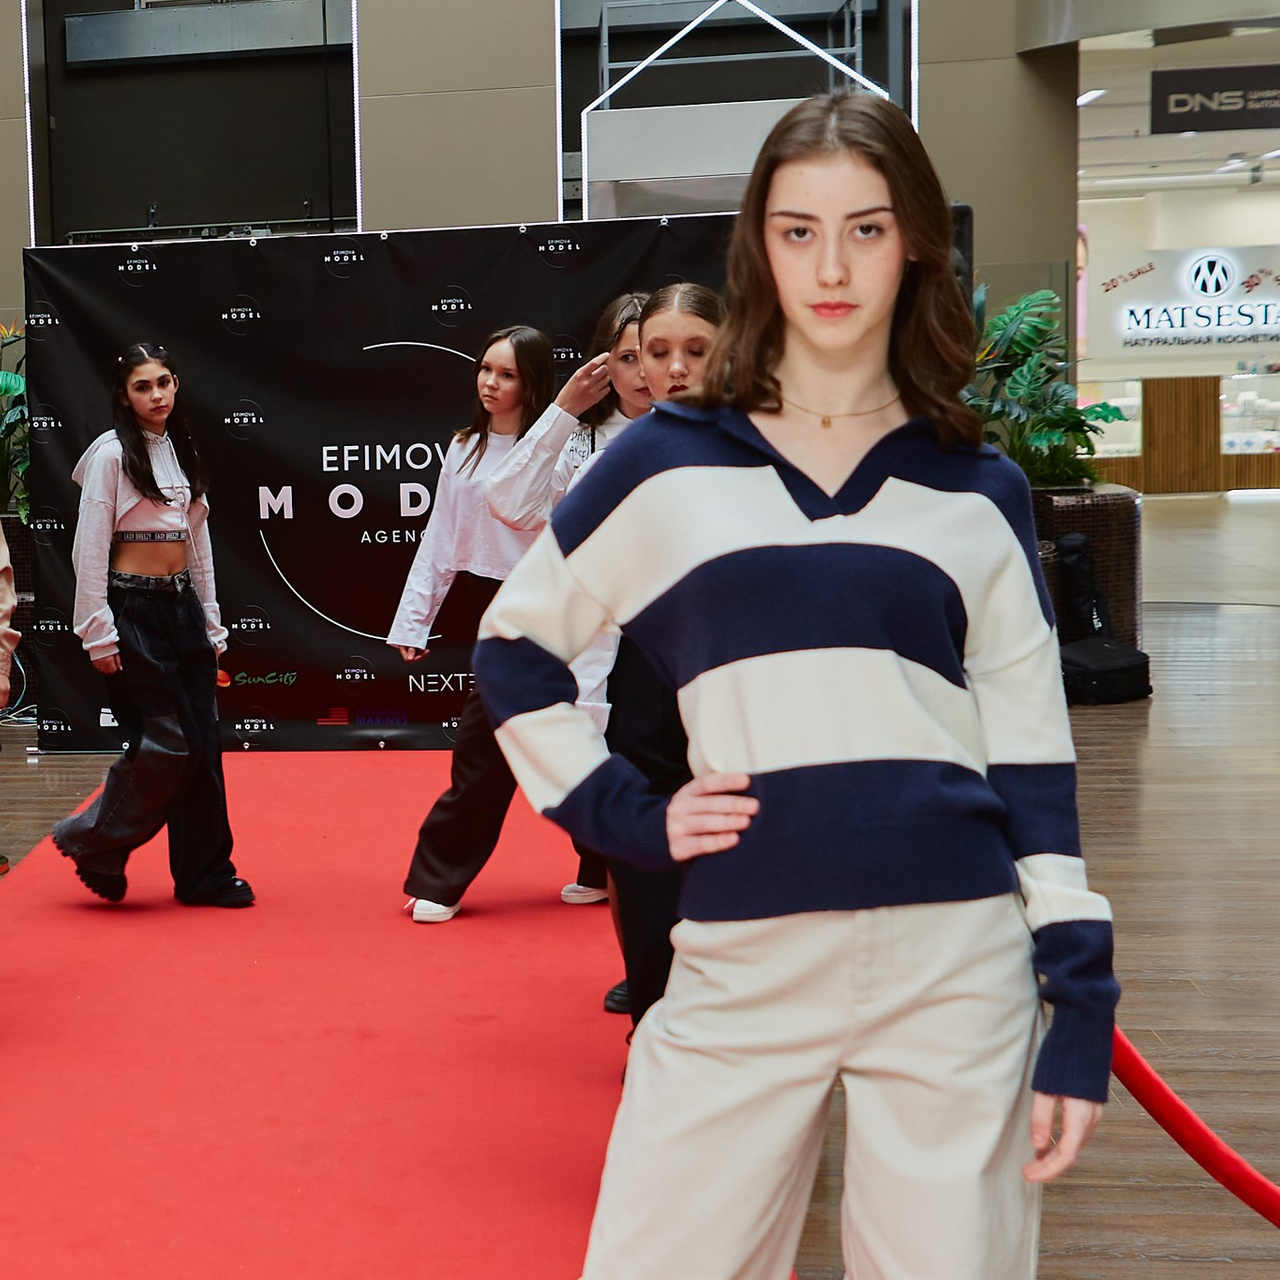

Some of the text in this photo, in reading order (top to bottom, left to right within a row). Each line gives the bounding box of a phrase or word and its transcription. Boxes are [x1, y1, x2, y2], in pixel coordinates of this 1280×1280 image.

[1167, 90, 1245, 114] DNS
[538, 243, 580, 252] MODEL
[324, 254, 365, 262] MODEL
[431, 303, 472, 311] MODEL
[258, 482, 431, 519] MOD
